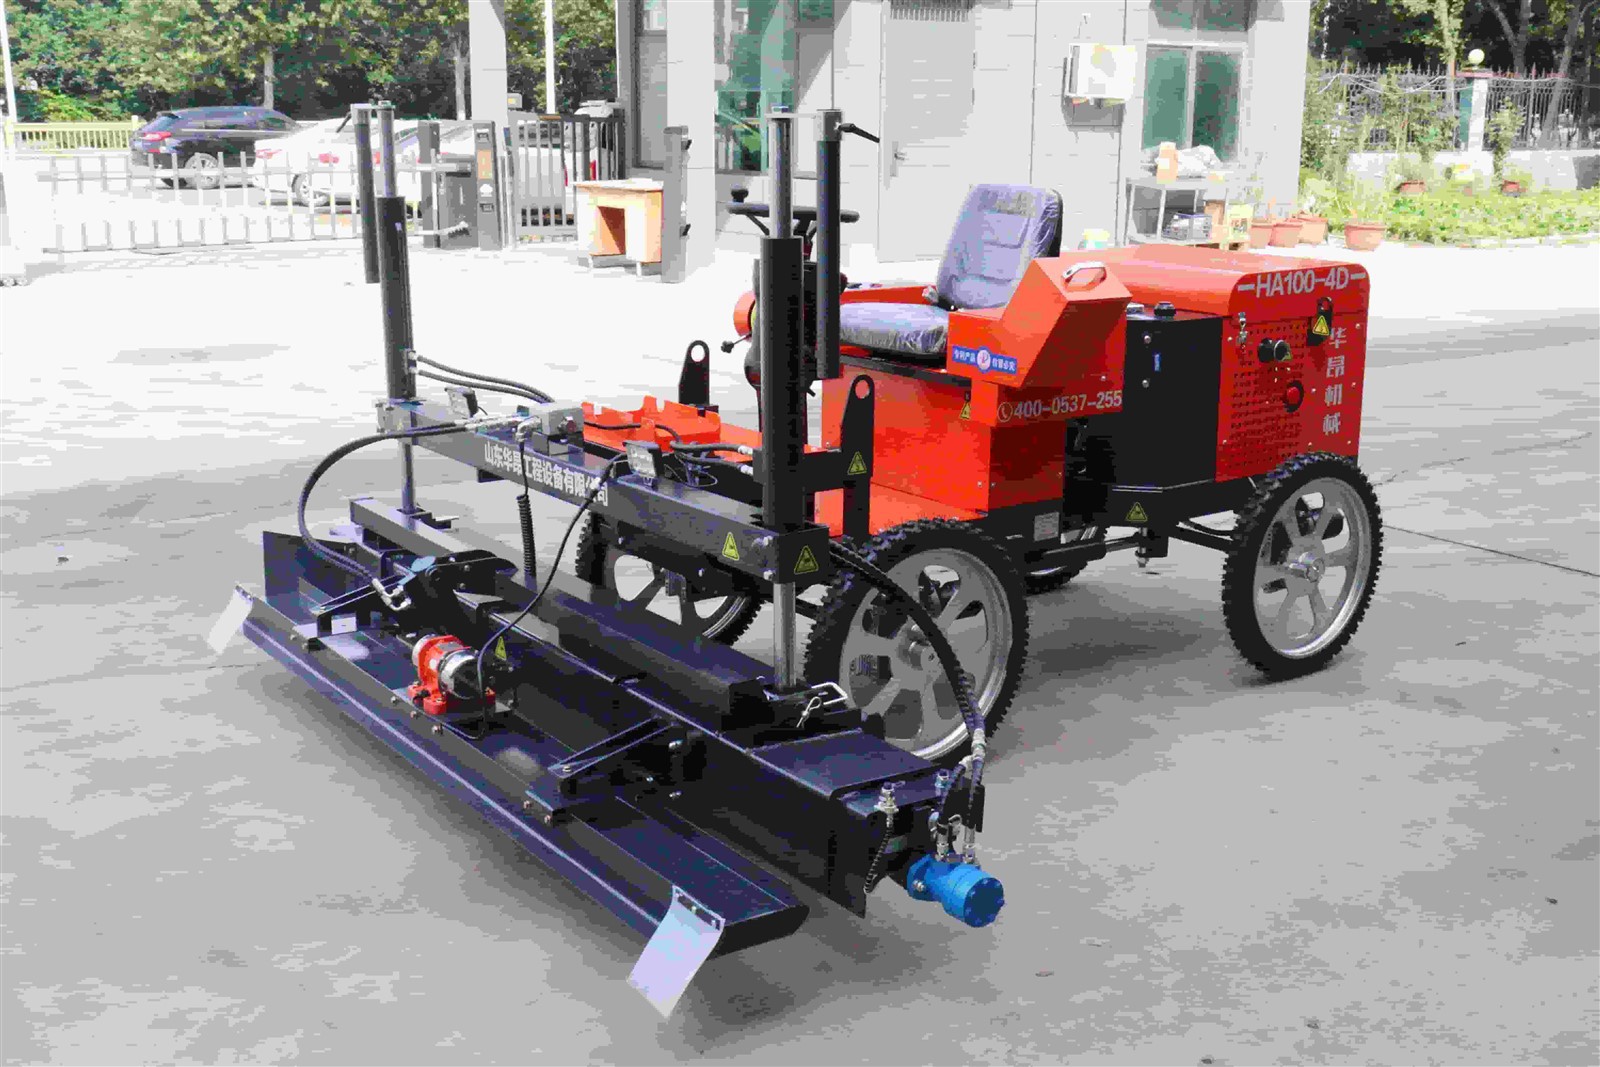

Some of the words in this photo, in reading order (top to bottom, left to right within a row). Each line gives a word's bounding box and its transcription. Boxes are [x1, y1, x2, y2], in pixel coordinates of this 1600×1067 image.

[1013, 389, 1123, 419] 400-0537-255
[1322, 326, 1347, 436] 华昂机械
